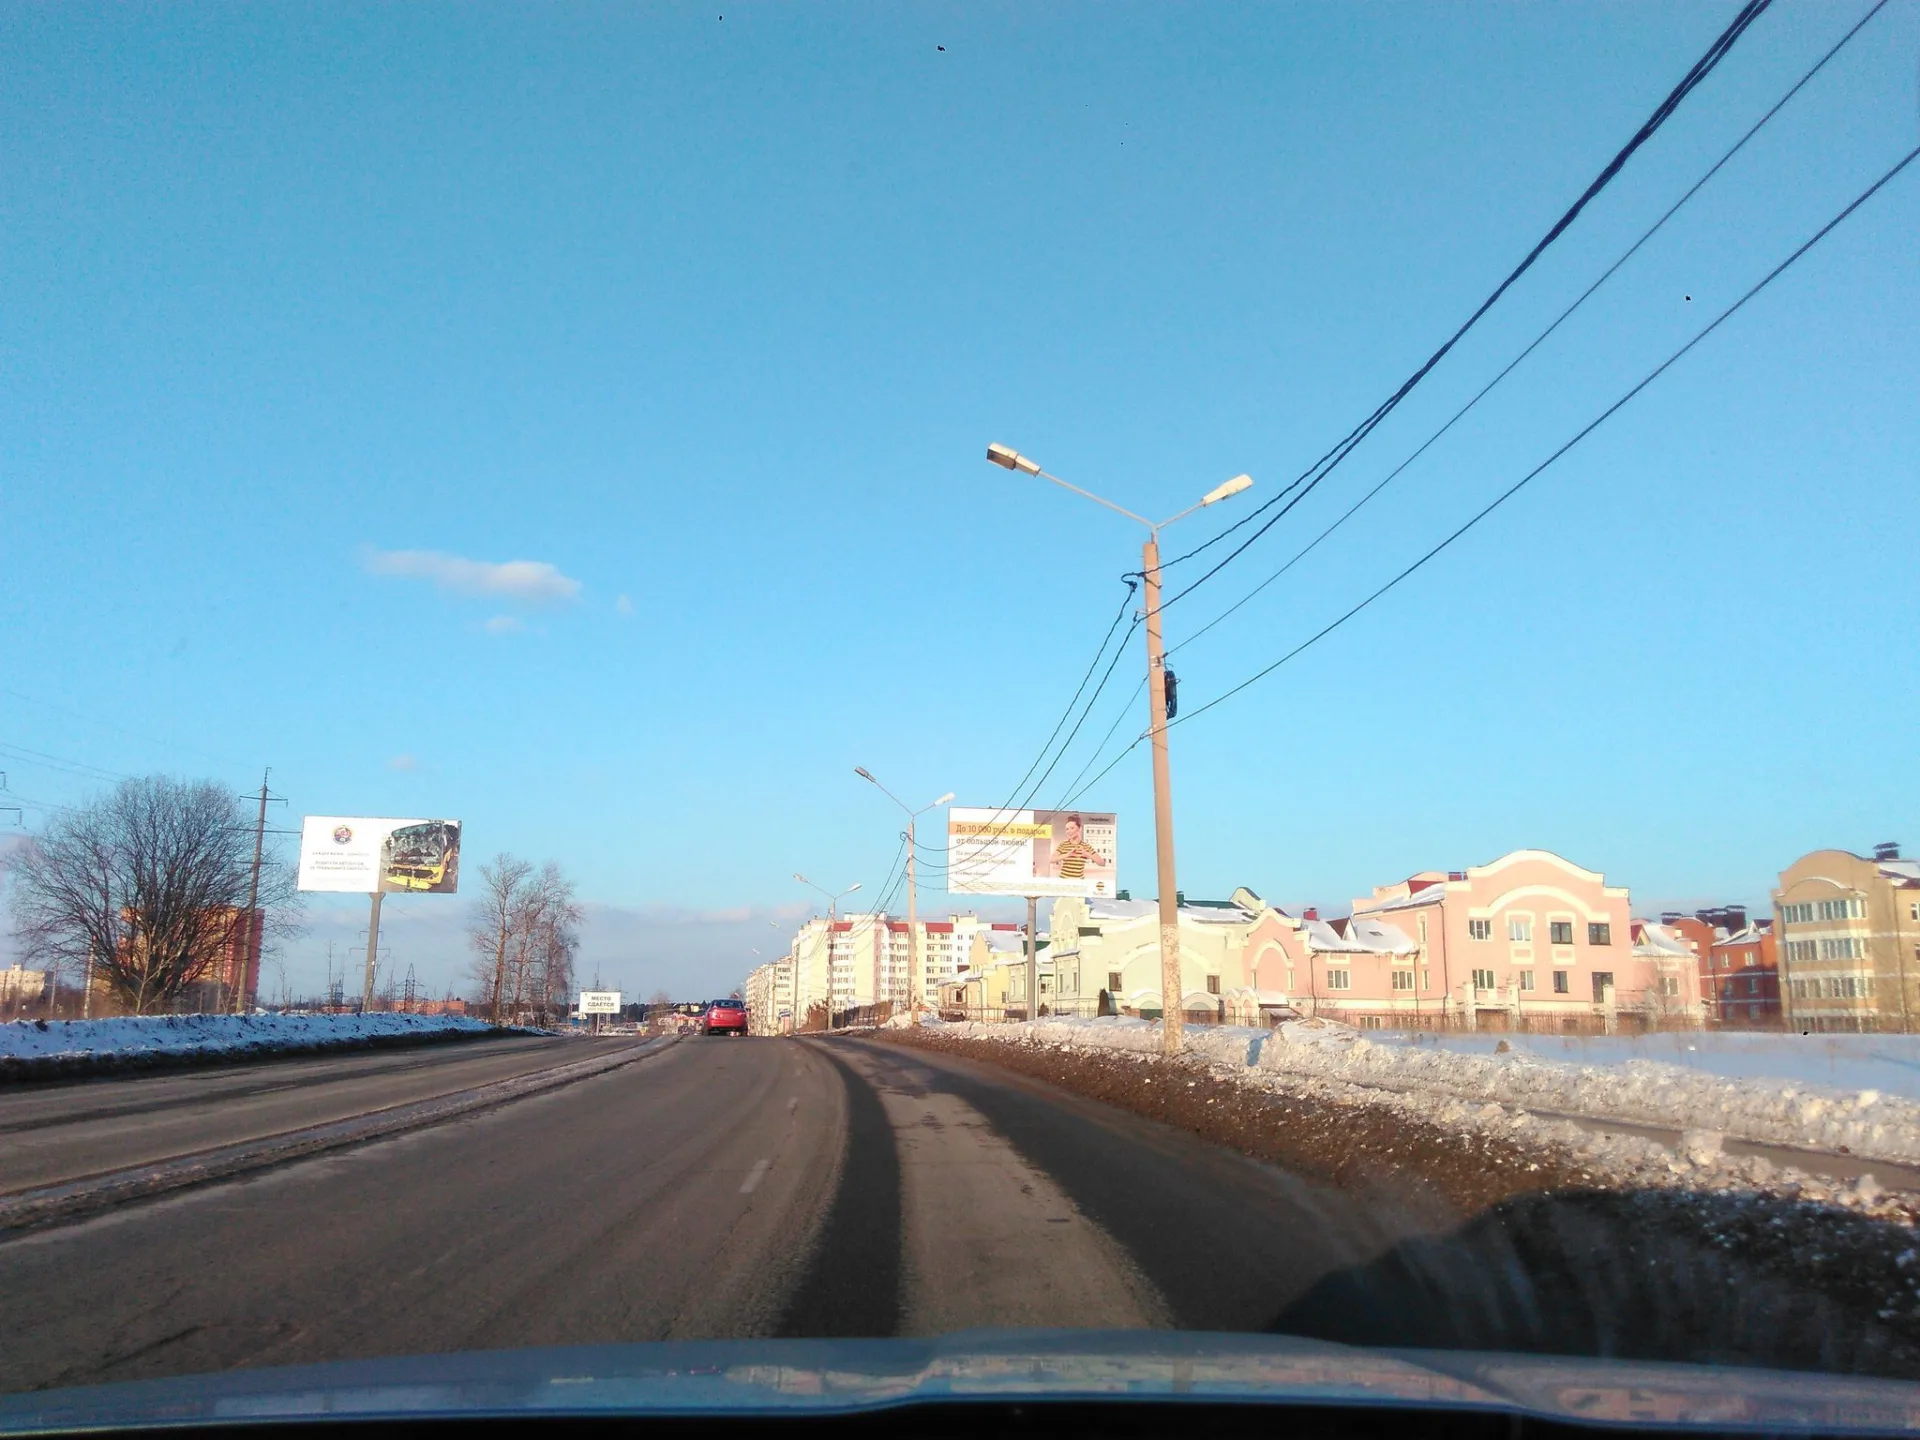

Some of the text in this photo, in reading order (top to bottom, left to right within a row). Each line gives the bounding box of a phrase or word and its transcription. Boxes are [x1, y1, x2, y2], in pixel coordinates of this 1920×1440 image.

[956, 824, 967, 833] До
[968, 825, 976, 833] 10
[1016, 828, 1046, 837] подарок
[966, 836, 999, 846] большой
[1000, 837, 1028, 847] любви!
